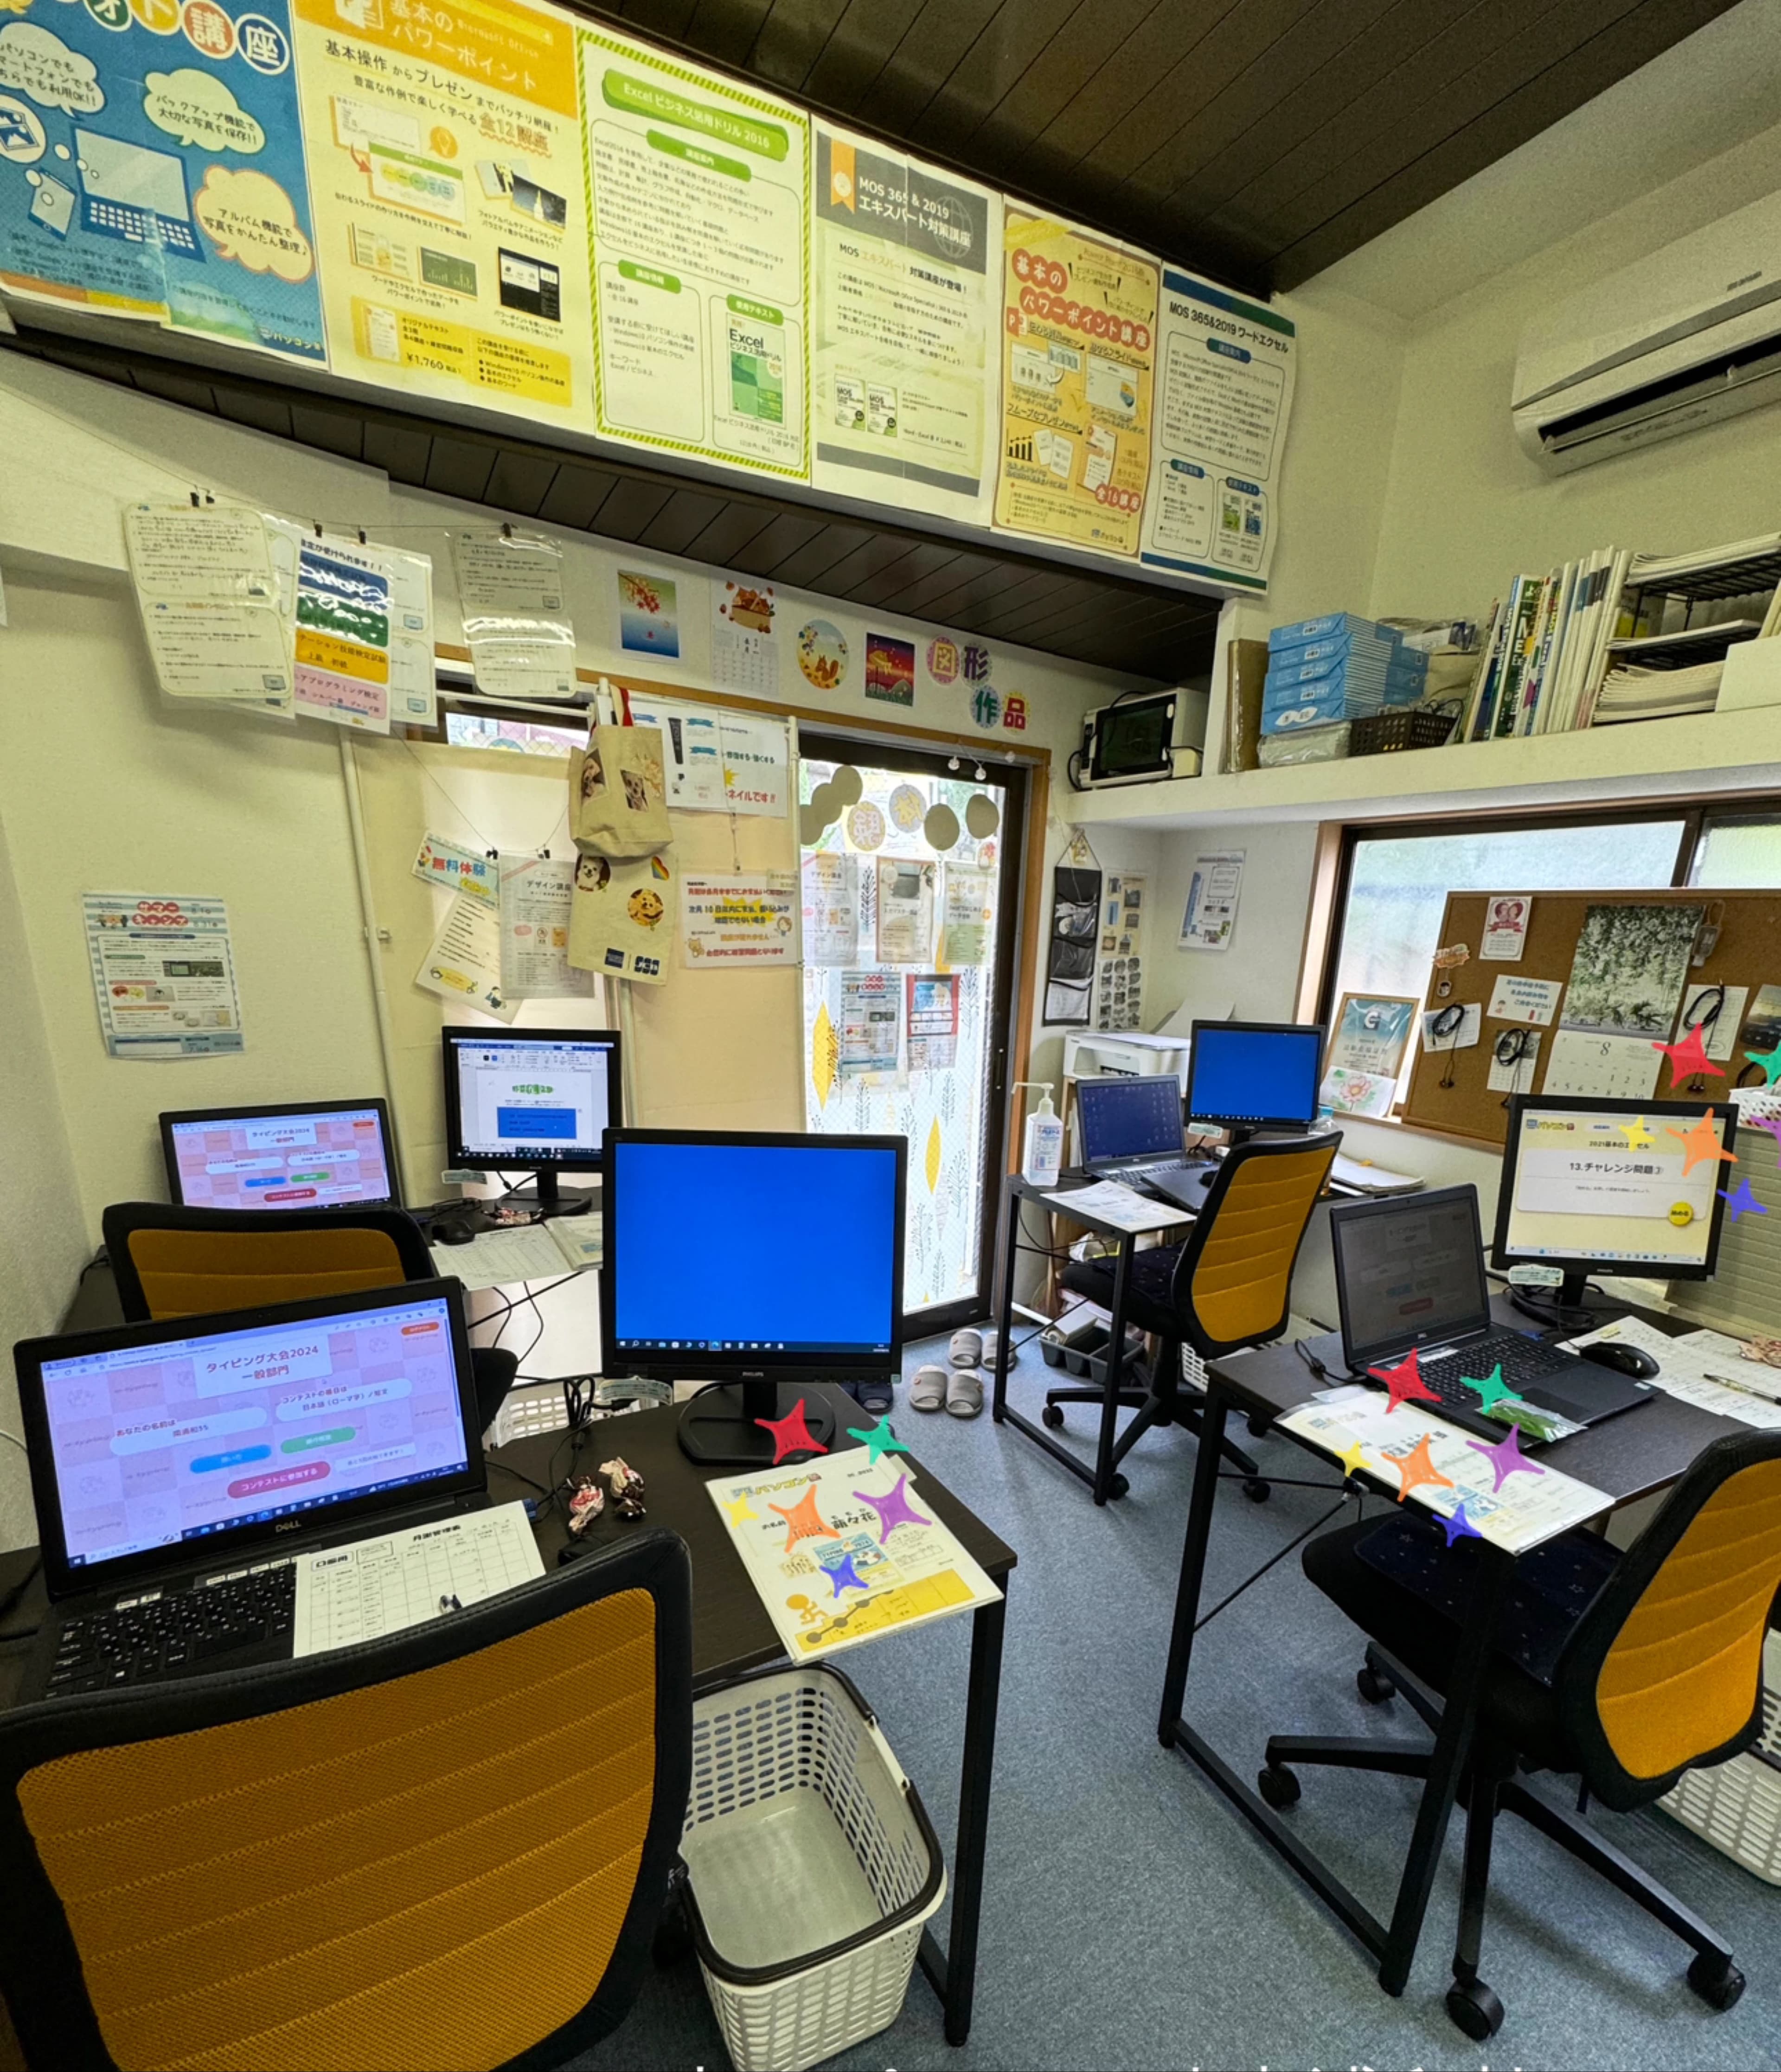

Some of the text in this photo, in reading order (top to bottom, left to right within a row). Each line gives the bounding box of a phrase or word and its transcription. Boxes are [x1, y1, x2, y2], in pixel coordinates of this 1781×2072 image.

[390, 0, 454, 32] 基本の
[393, 23, 537, 91] パワーポイント
[156, 96, 256, 130] バックアップ機能で
[623, 82, 770, 148] Excel ビジネス活用ドリル 2016
[858, 176, 949, 220] MOS 365 & 2019
[218, 208, 293, 237] アルバム機能で
[858, 195, 972, 249] エキスパート対策講座
[839, 243, 860, 257] MOS
[862, 251, 907, 274] エキスパート
[1016, 255, 1063, 286] 基本の
[1023, 294, 1147, 347] パワーポイント講座
[1169, 301, 1189, 319] MOS
[1238, 327, 1289, 354] ワードエクセル
[729, 327, 764, 349] Excel
[932, 641, 988, 681] 図形
[975, 691, 1026, 731] 作品
[725, 788, 776, 804] ネイルです!!
[433, 857, 487, 877] 無料体験
[526, 880, 571, 891] デザイン講座
[634, 956, 660, 976] JCB
[1600, 1042, 1612, 1056] 8
[1577, 1084, 1584, 1093] 6
[1610, 1074, 1646, 1087] 1 2 3
[1589, 1140, 1650, 1150] 2021基本のエセル
[205, 1344, 320, 1374] タイピング大会2024
[241, 1365, 289, 1383] 一般部門
[115, 1418, 175, 1437] あなたの名前は
[240, 1467, 319, 1492] コンテストに参加する
[275, 1519, 302, 1533] DELL
